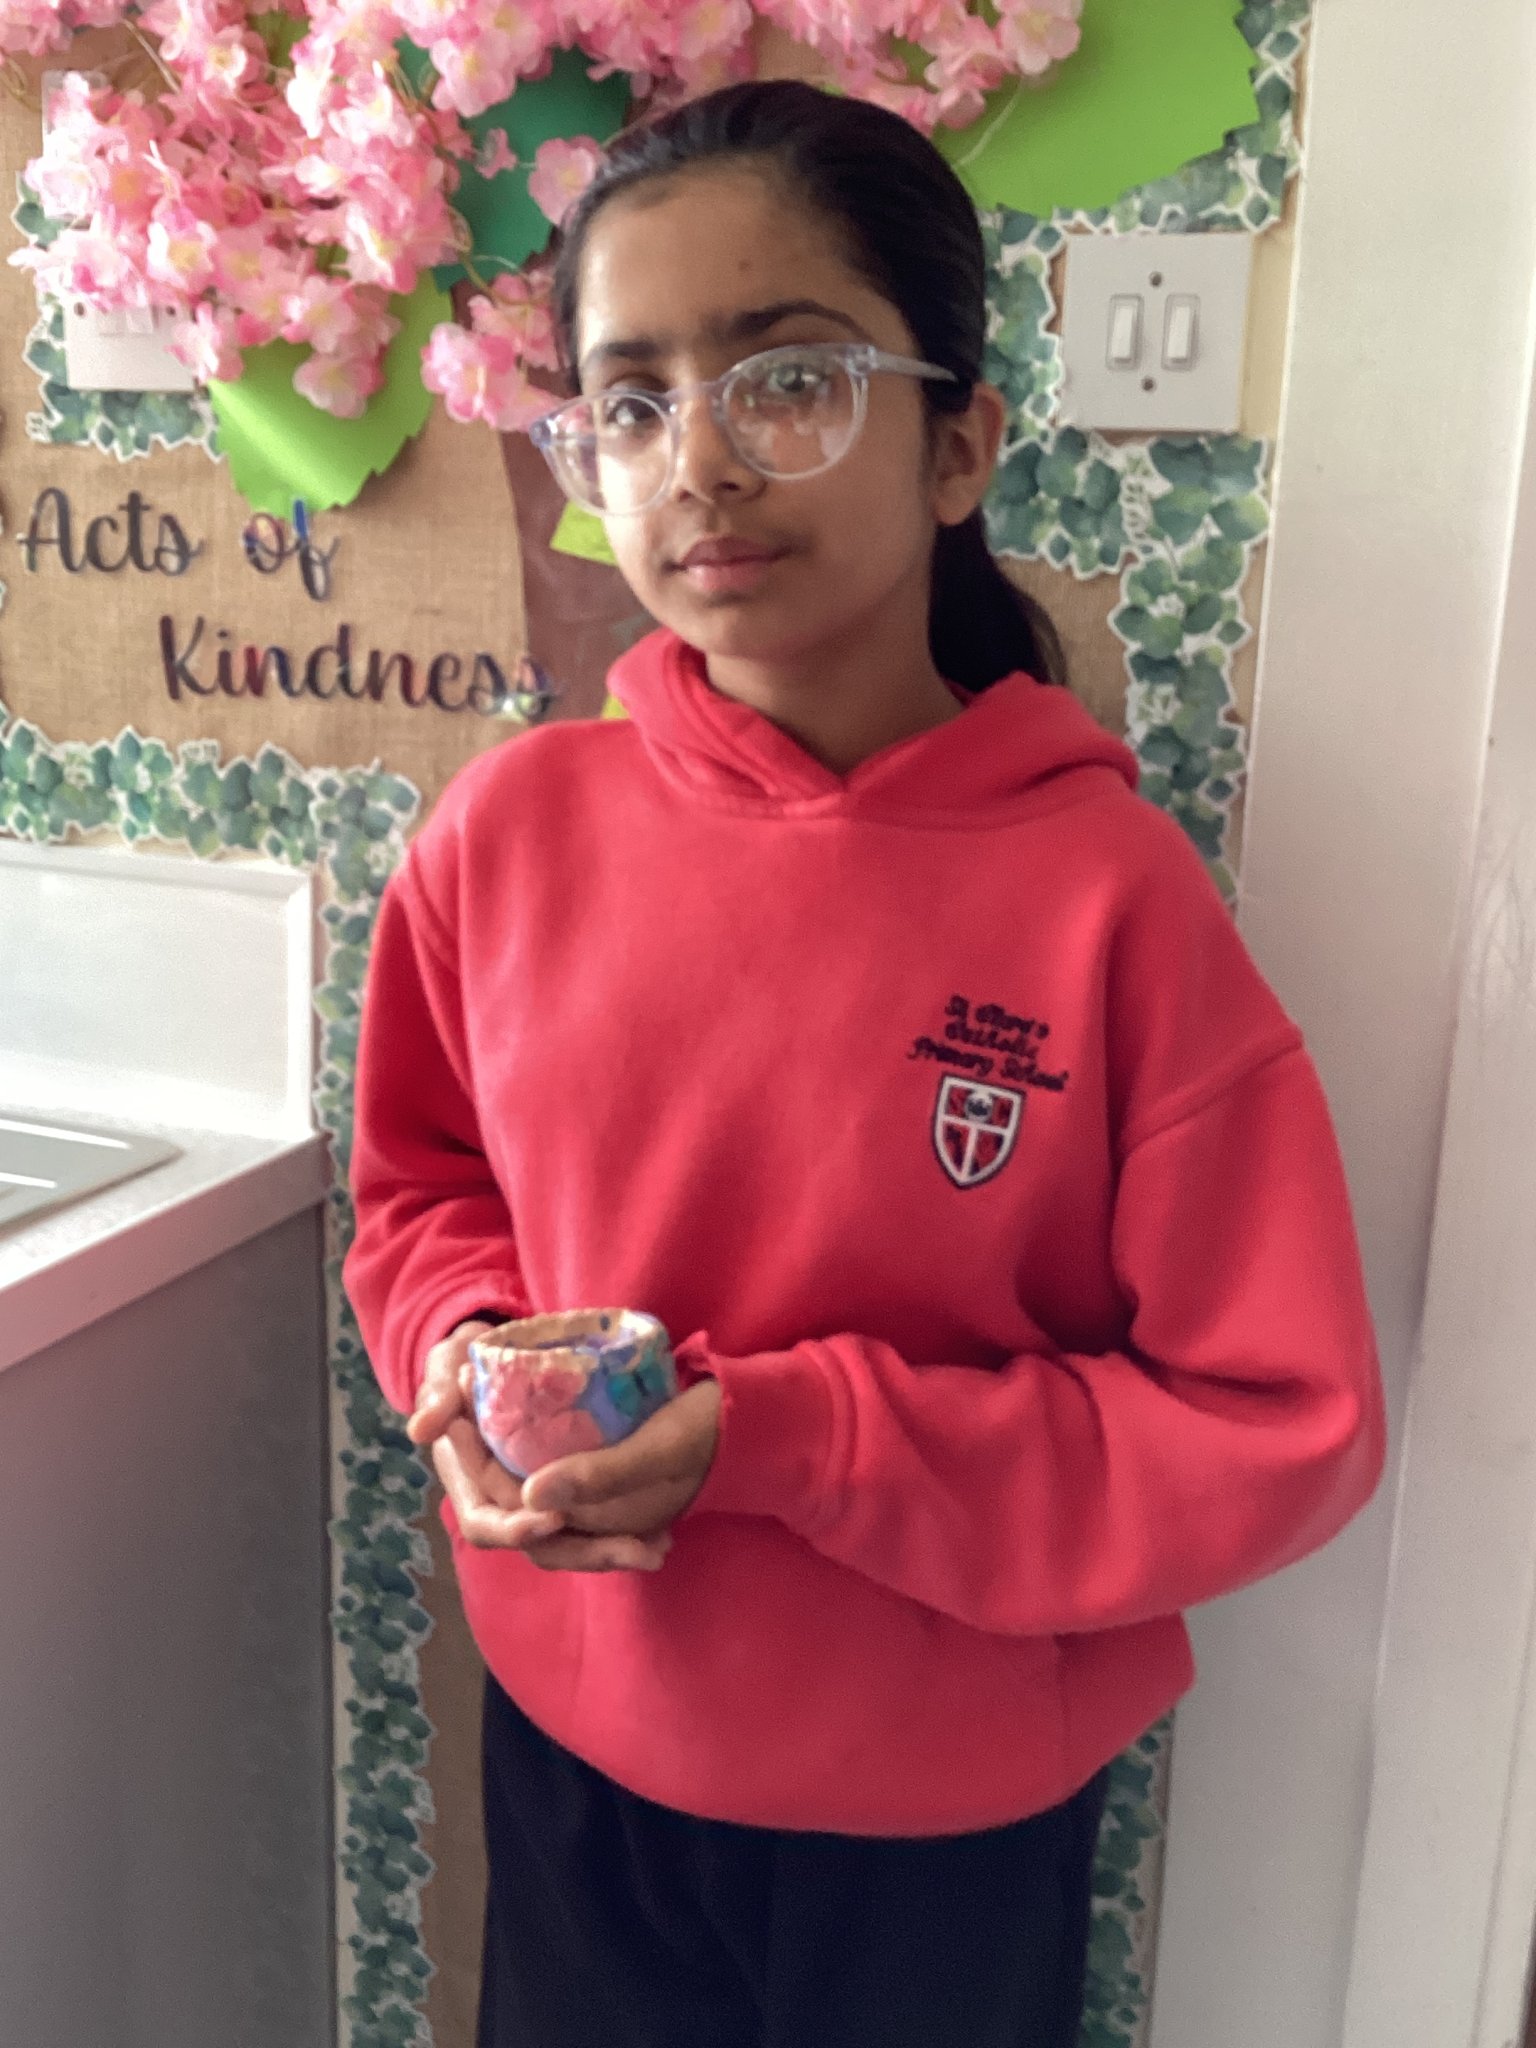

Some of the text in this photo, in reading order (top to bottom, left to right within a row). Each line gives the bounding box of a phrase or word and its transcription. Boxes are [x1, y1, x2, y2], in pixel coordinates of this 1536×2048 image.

[17, 487, 341, 602] Acts of
[159, 614, 558, 721] Kindness
